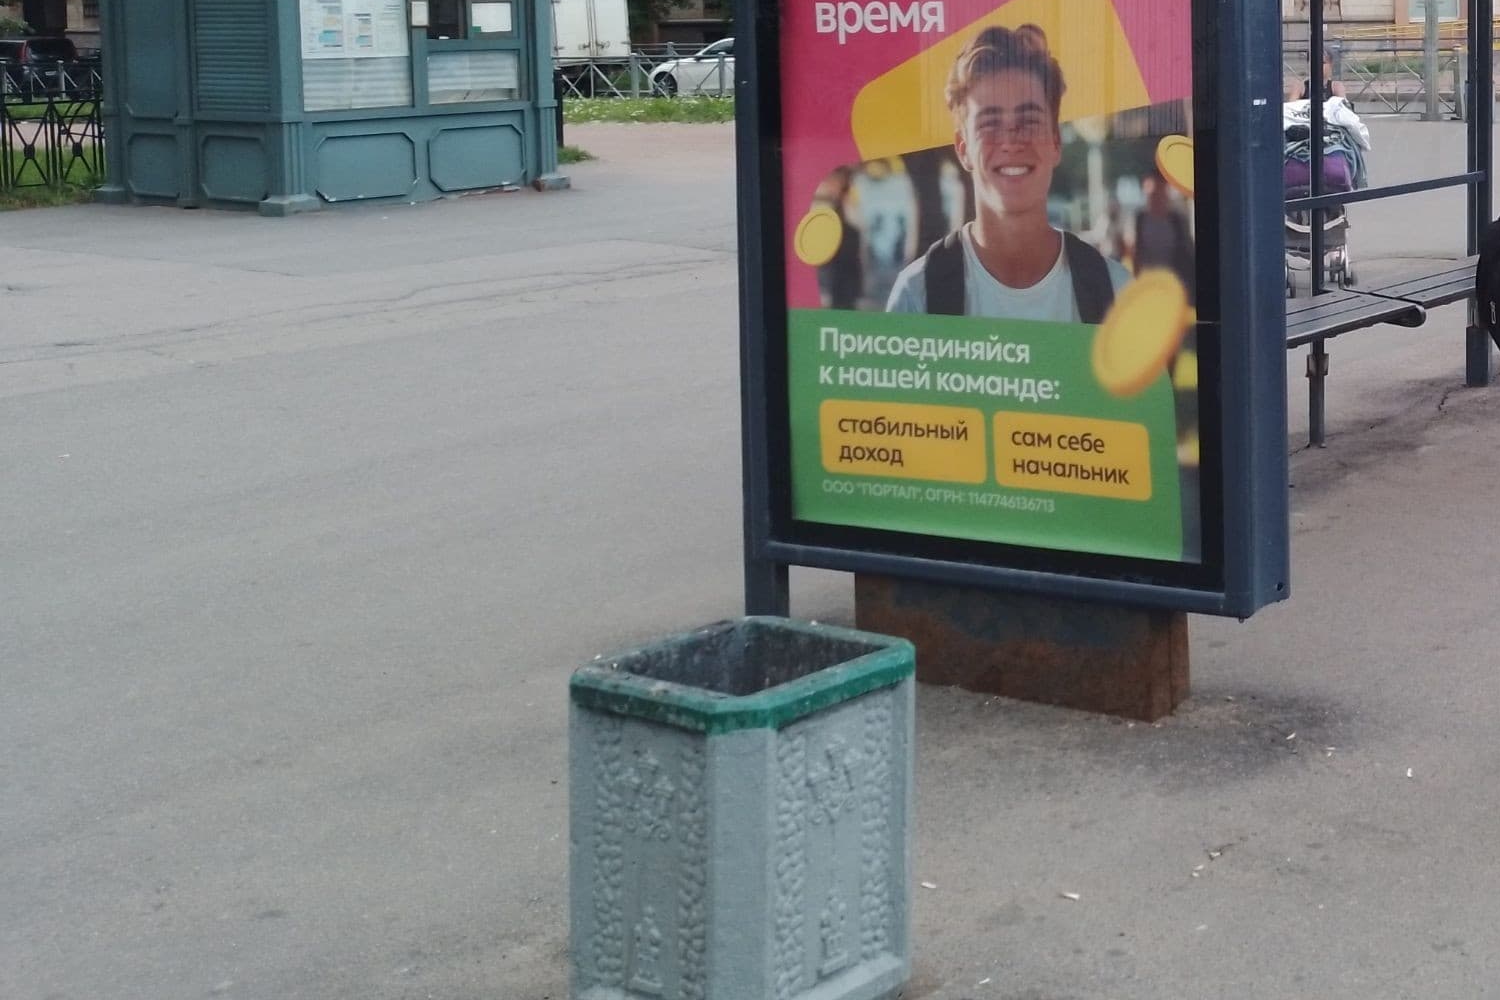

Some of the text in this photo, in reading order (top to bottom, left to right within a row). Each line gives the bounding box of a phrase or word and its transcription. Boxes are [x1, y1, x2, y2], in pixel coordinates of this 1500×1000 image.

[815, 0, 945, 44] время
[819, 327, 1030, 364] Присоединяйся
[819, 363, 1060, 403] к нашей команде:
[838, 416, 968, 441] стабильный
[1011, 430, 1105, 454] сам себе
[838, 445, 903, 467] доход
[1012, 459, 1130, 486] начальник
[822, 480, 854, 494] ООО
